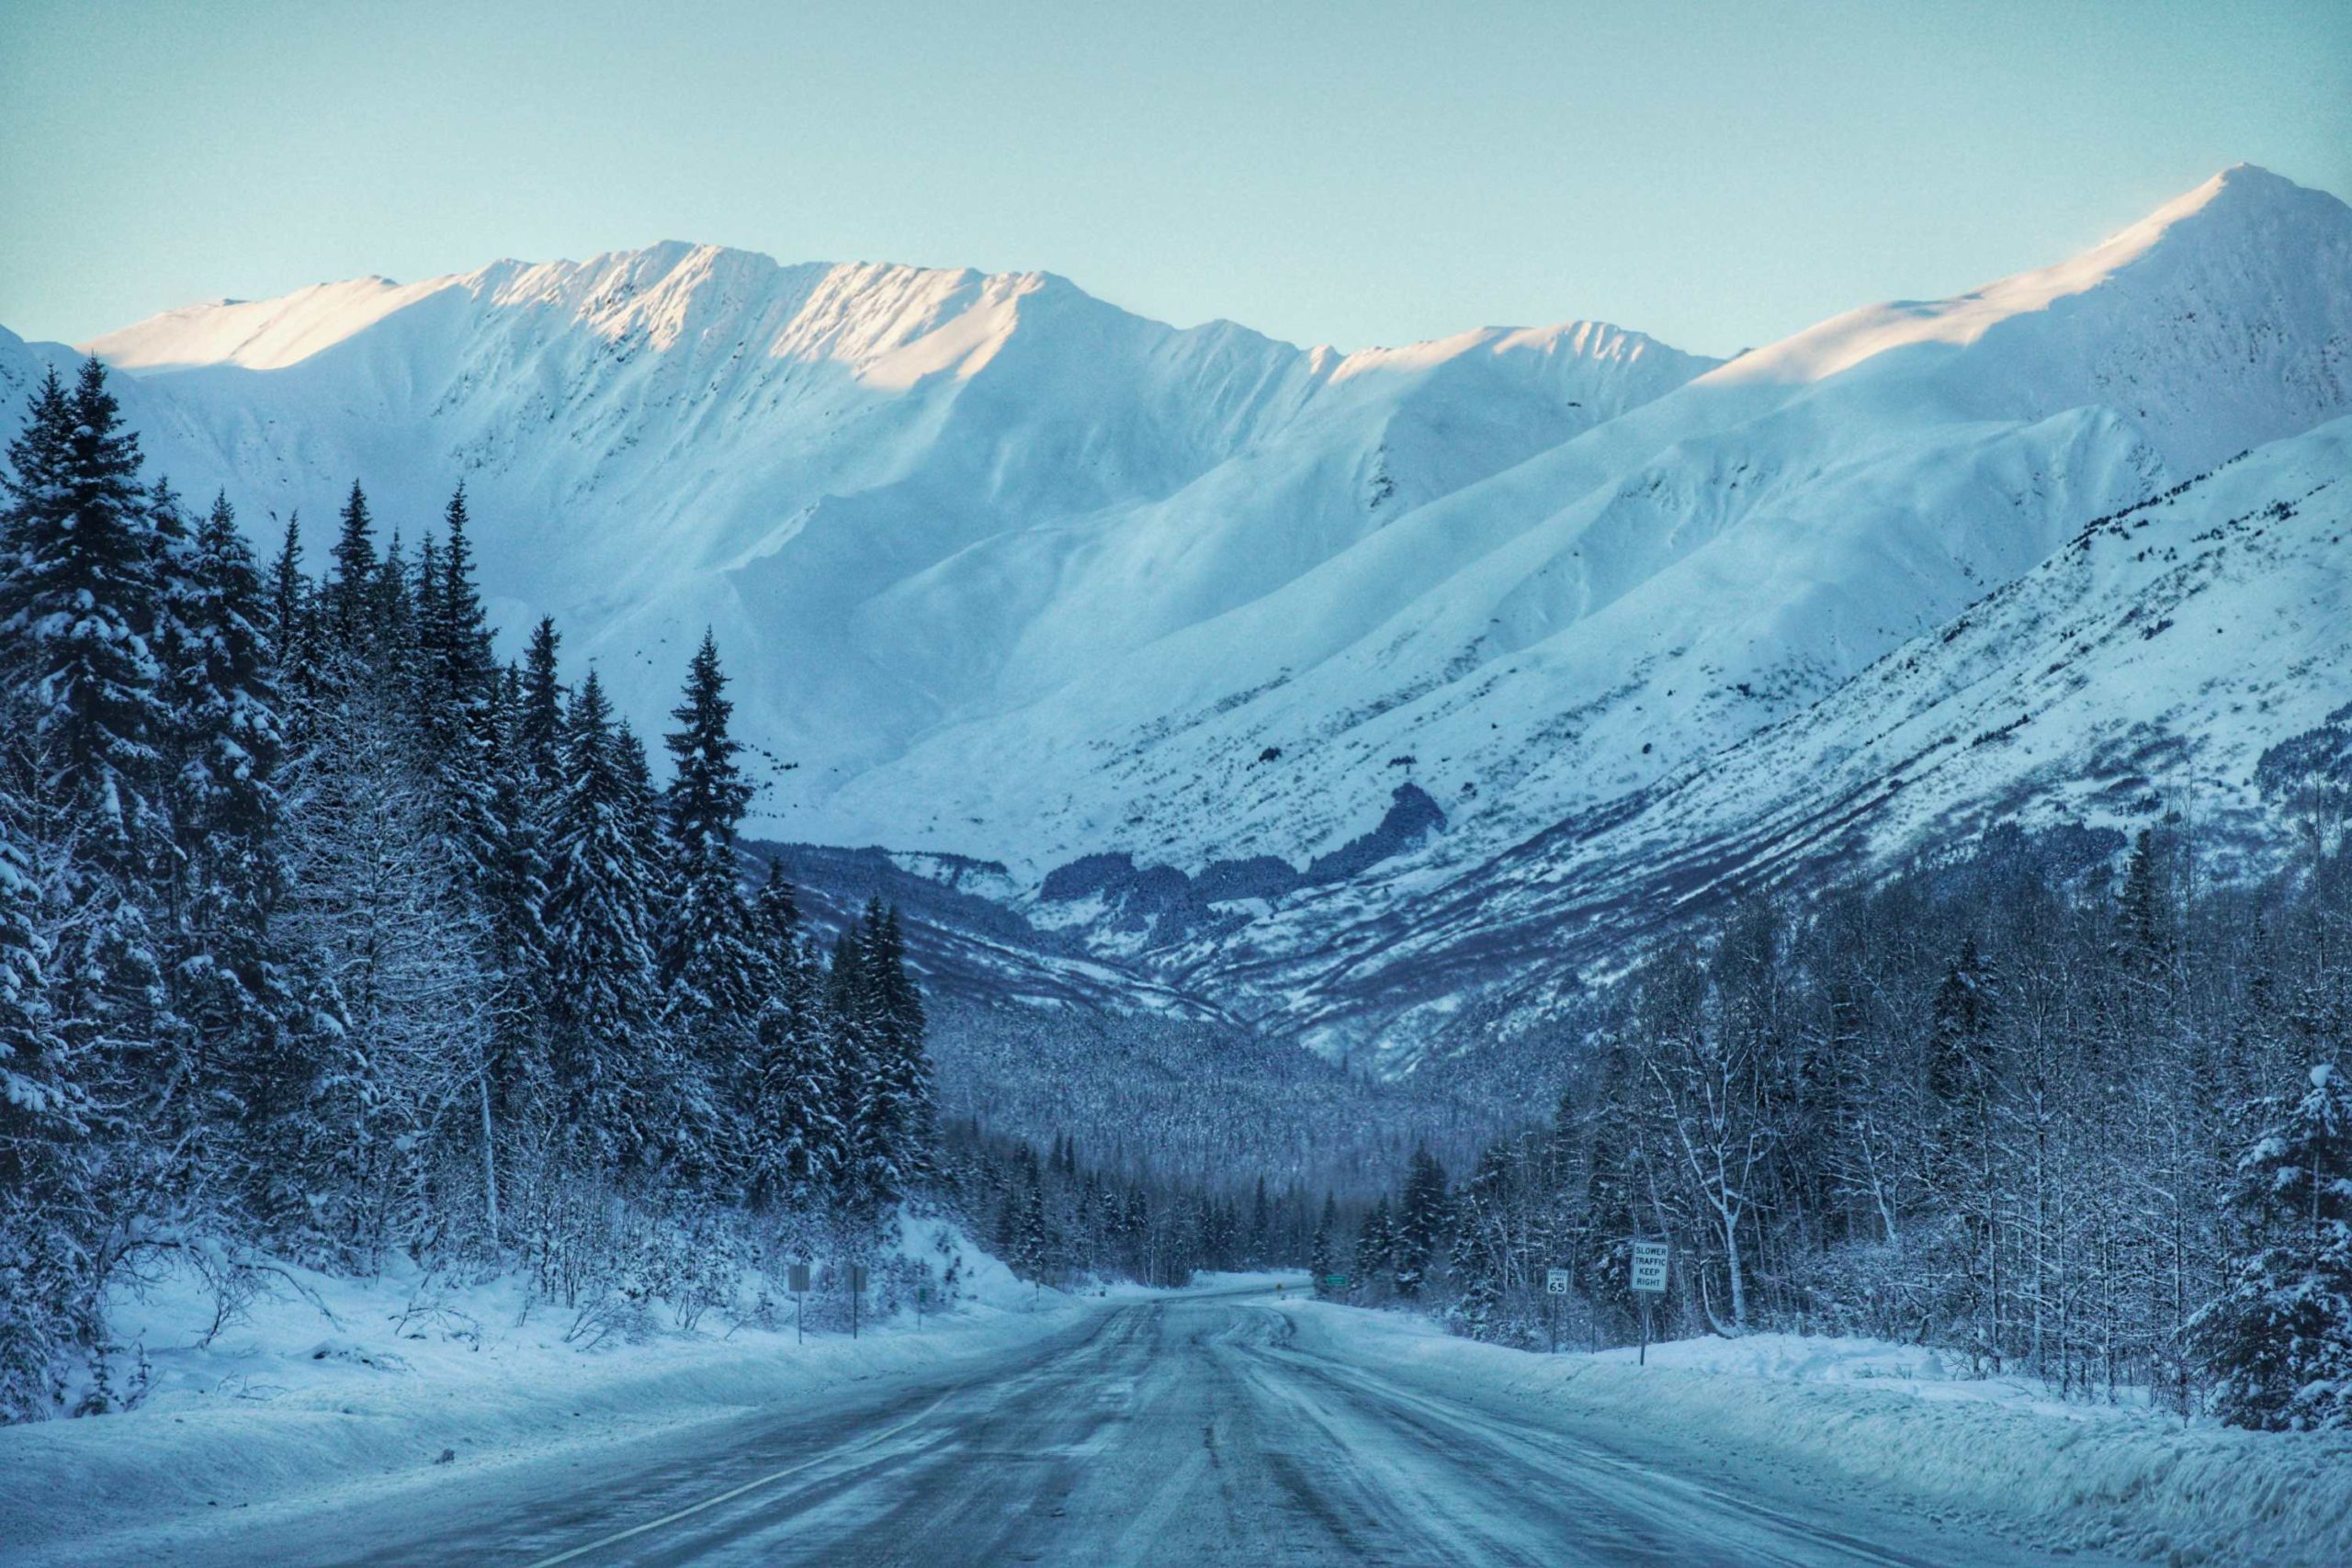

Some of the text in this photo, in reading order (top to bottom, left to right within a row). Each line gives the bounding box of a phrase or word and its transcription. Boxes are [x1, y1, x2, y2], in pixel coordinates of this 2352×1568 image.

[1636, 1247, 1667, 1256] SLOWER
[1635, 1257, 1666, 1266] TRAFFIC
[1639, 1268, 1660, 1276] KEEP
[1550, 1282, 1565, 1292] 65
[1636, 1279, 1660, 1287] RIGHT
